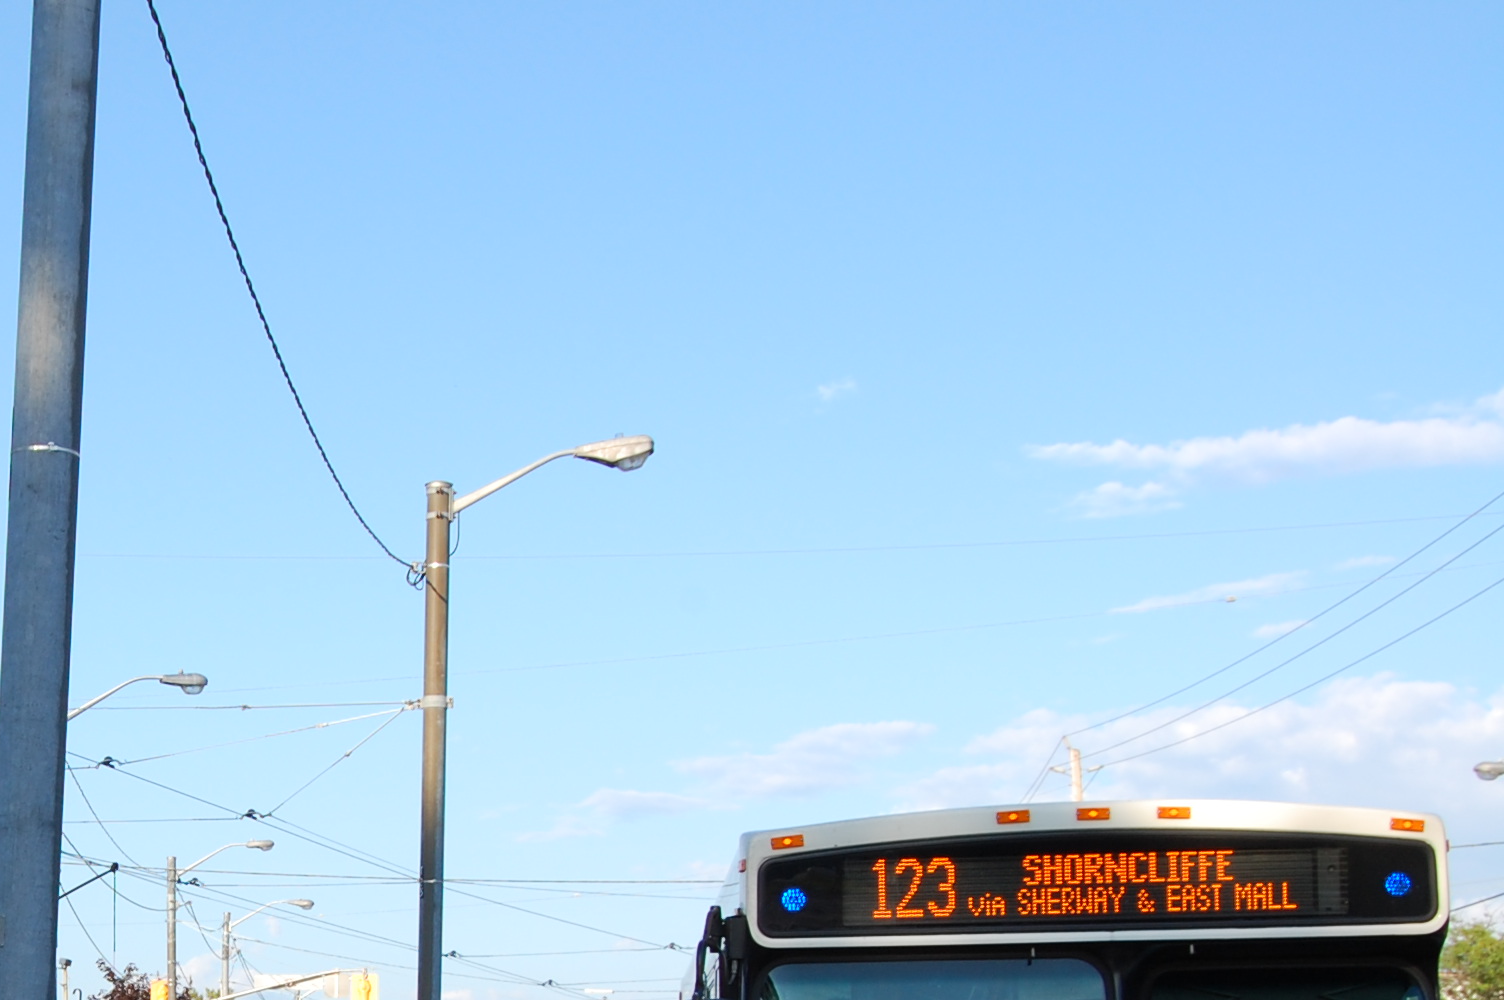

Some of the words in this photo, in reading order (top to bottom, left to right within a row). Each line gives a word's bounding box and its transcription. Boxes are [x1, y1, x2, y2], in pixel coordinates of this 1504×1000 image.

[1021, 849, 1235, 886] SHORNCLIFFE
[871, 856, 957, 919] 123
[967, 892, 1006, 917] via
[1016, 885, 1127, 916] SHERWAY
[1136, 888, 1156, 913] &
[1165, 884, 1223, 912] EAST
[1234, 881, 1299, 911] MALL
